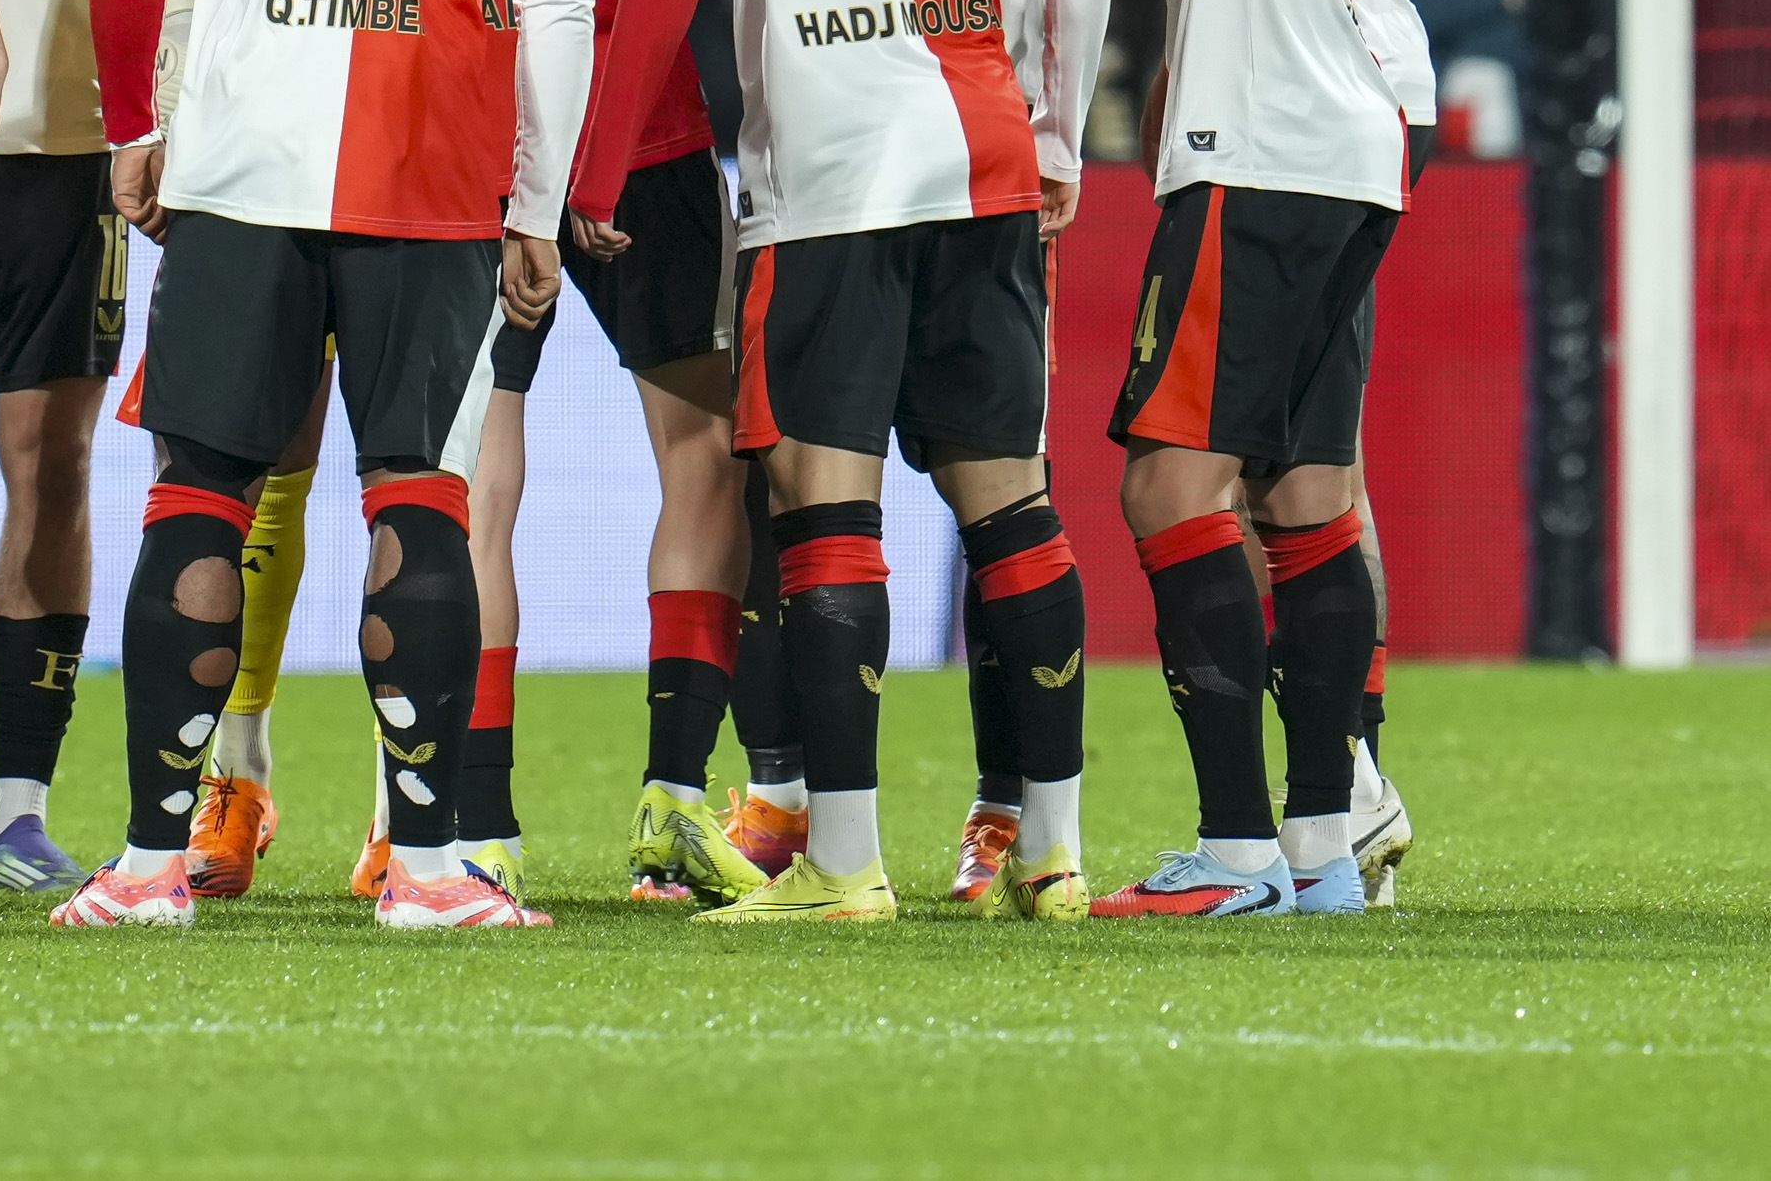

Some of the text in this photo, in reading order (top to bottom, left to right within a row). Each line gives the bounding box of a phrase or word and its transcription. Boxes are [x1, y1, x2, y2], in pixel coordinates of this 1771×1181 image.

[794, 1, 896, 47] HADJ
[98, 214, 128, 300] 16
[30, 648, 84, 691] F
